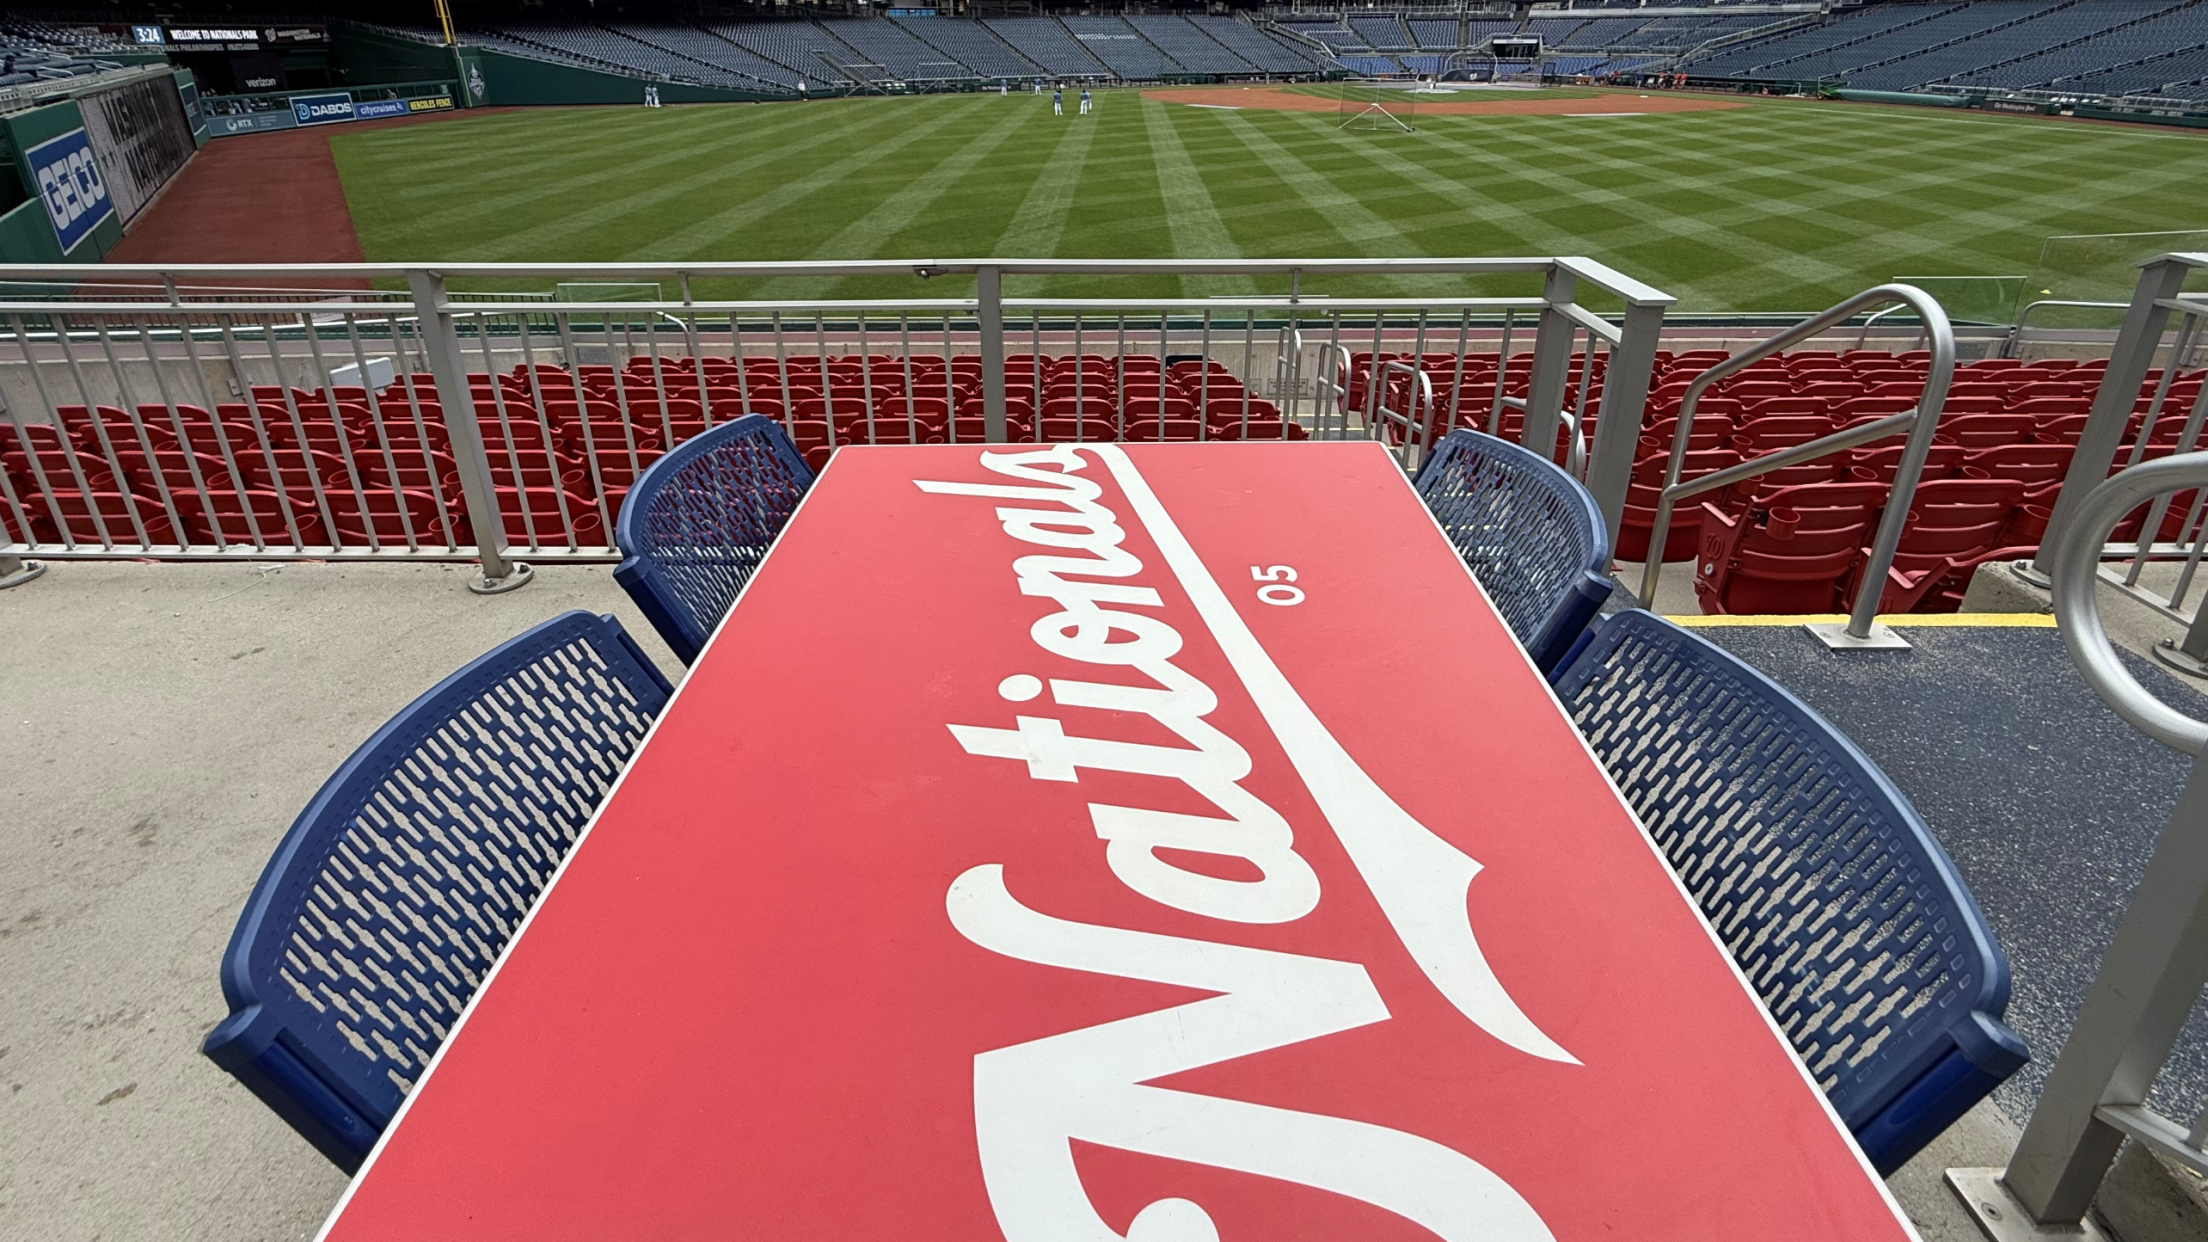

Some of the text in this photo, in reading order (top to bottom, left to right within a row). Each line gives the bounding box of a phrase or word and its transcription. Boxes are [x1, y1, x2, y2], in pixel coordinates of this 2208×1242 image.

[136, 28, 161, 42] 3:24
[170, 29, 259, 40] WELCOME TO NATIONALS PARK
[245, 77, 277, 87] verizon
[310, 103, 353, 116] DABOS
[360, 104, 397, 115] citycruises
[409, 98, 452, 110] HERCULES FENCE
[238, 119, 253, 128] RTX
[38, 146, 106, 230] GEICO
[1250, 564, 1306, 607] 05
[912, 443, 1558, 1242] Nationals
